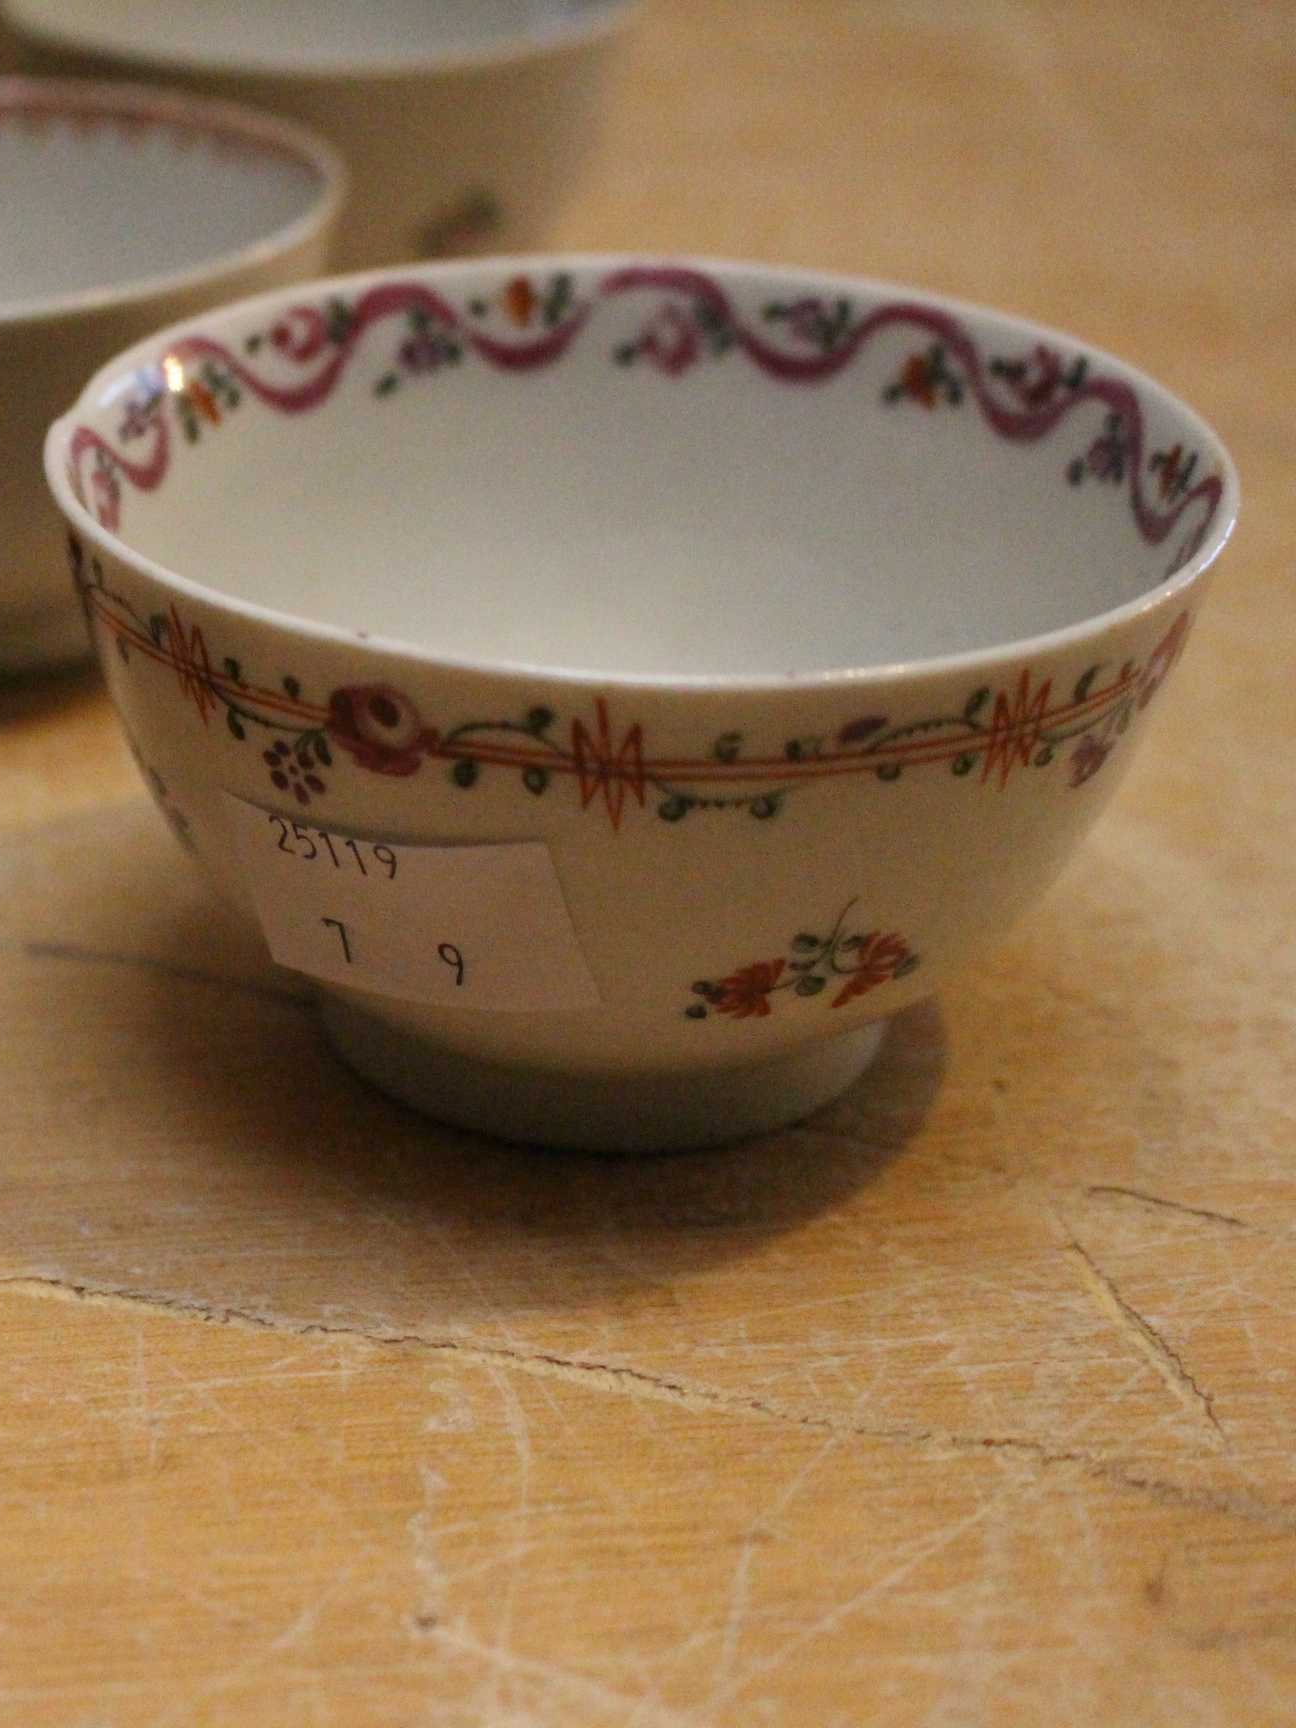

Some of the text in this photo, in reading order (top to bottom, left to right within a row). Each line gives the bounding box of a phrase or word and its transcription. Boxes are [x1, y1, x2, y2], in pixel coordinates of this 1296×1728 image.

[268, 814, 398, 880] 25119
[321, 917, 465, 986] 7 9
